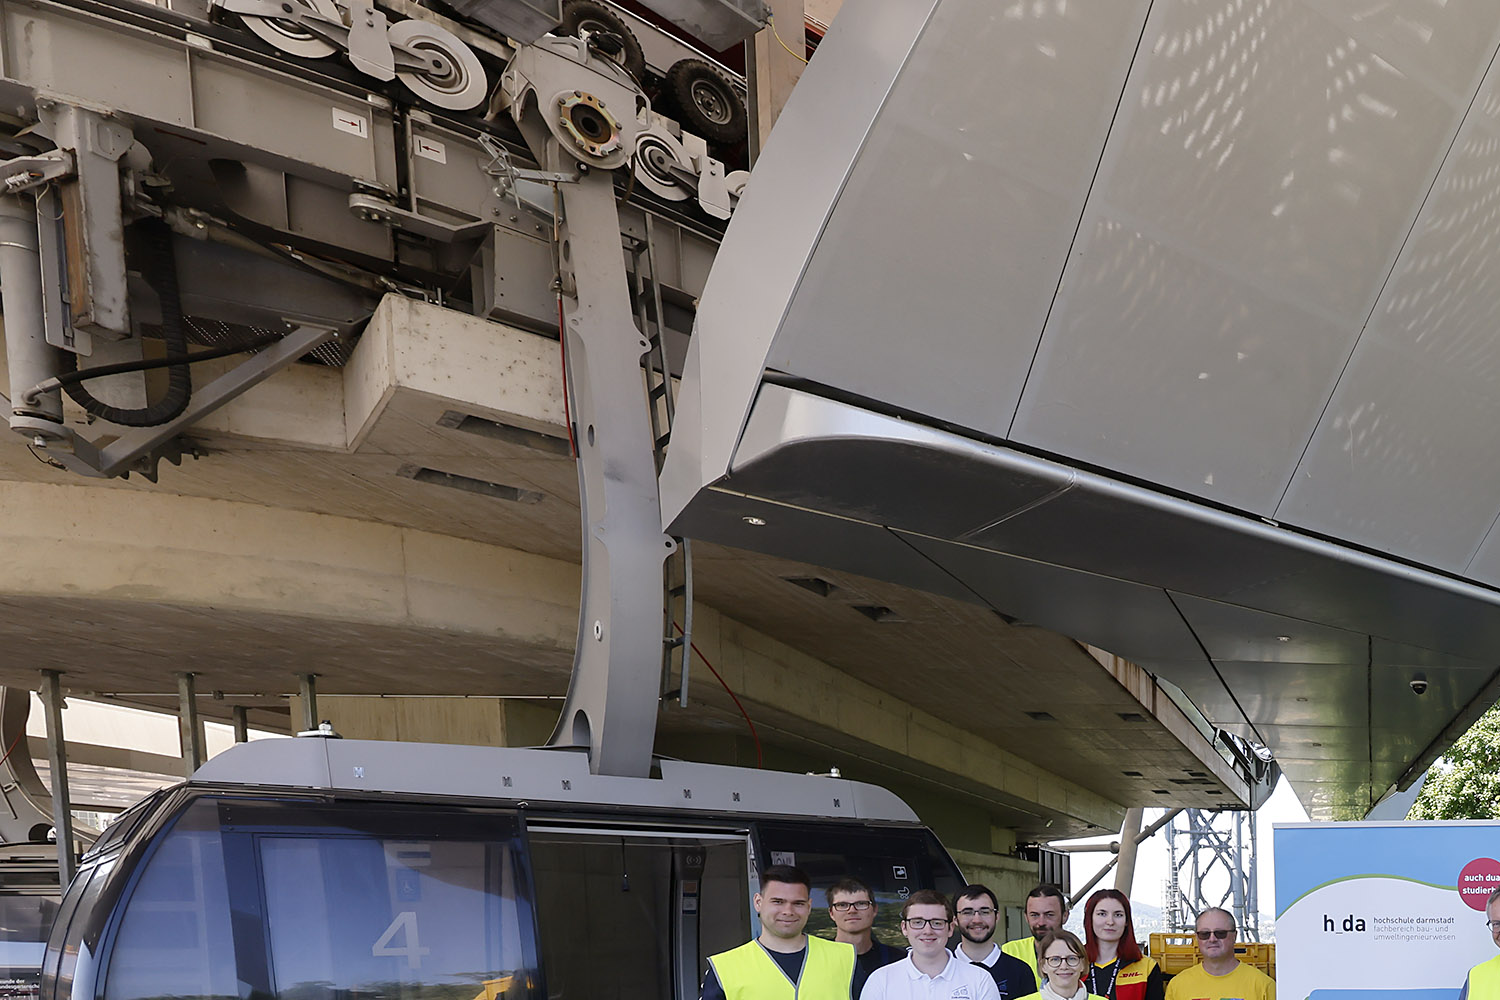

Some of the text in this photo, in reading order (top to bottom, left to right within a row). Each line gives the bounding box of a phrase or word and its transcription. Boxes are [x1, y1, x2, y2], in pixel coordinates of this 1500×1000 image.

[1464, 874, 1484, 882] auch
[1324, 914, 1366, 934] h_da
[372, 912, 430, 969] 4
[1374, 934, 1456, 942] umweltingenieurwesen
